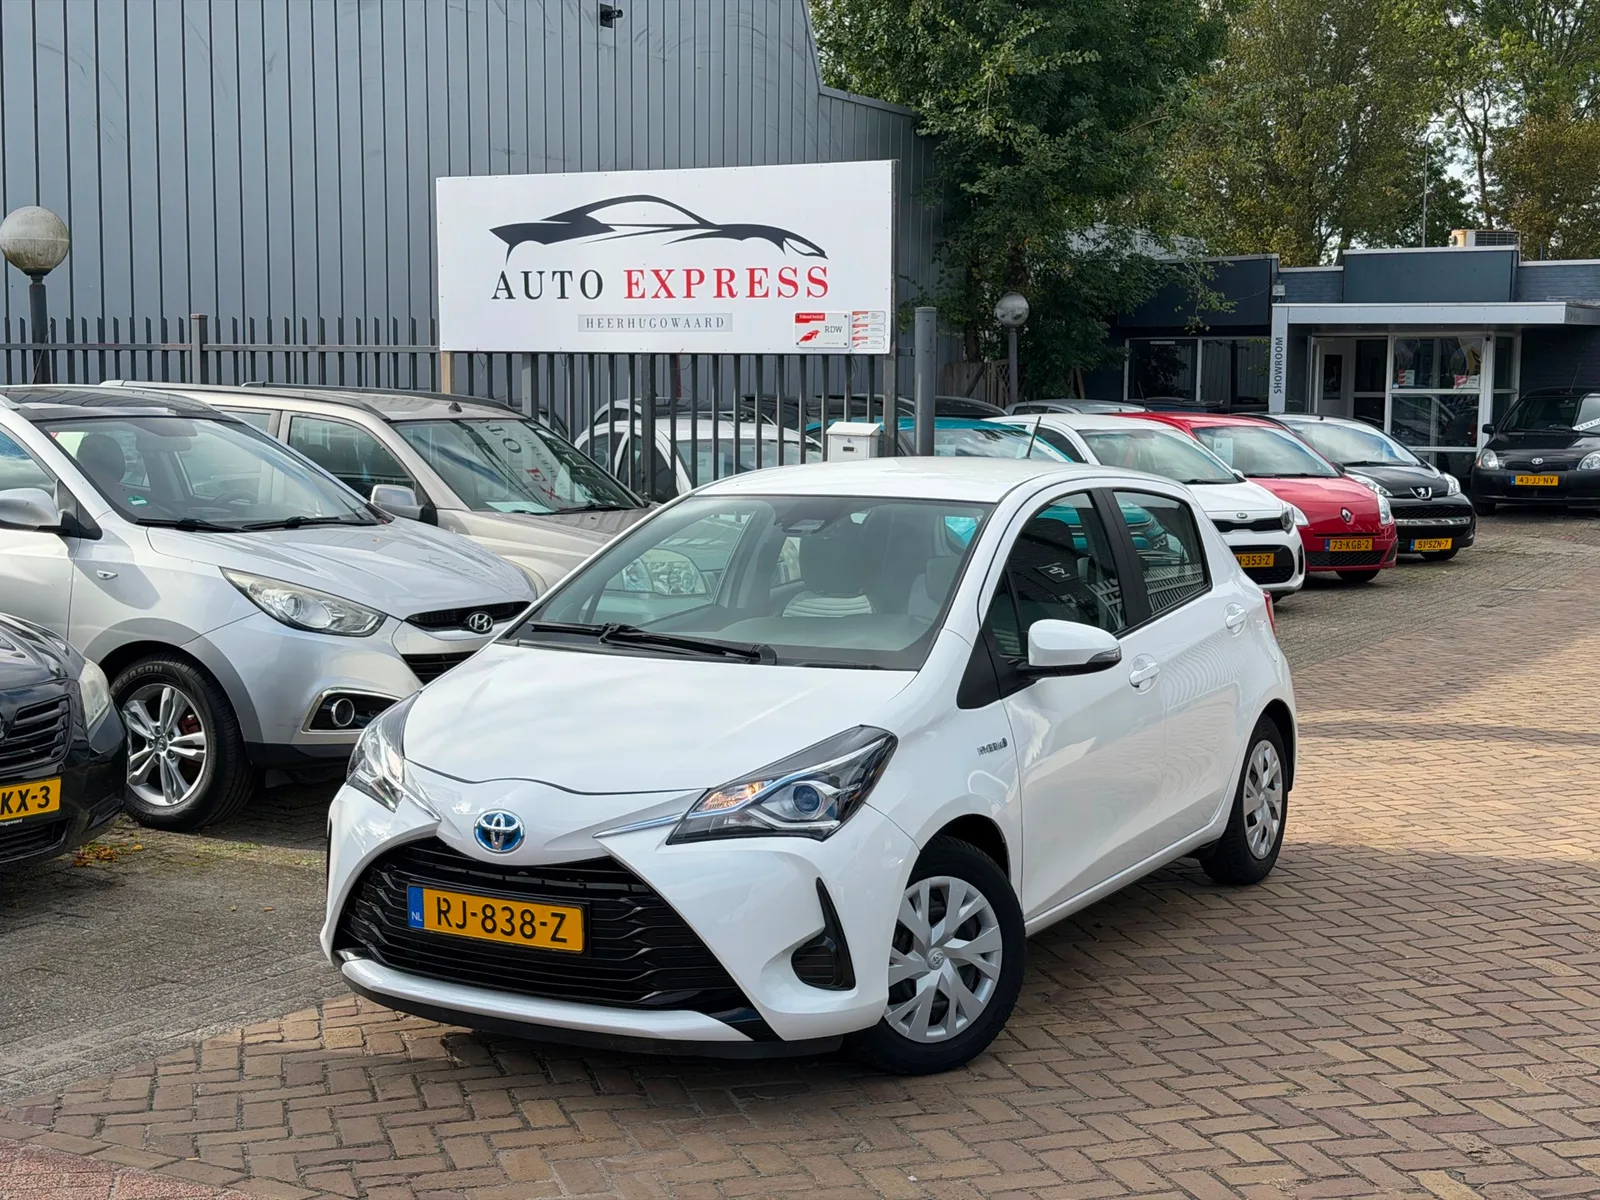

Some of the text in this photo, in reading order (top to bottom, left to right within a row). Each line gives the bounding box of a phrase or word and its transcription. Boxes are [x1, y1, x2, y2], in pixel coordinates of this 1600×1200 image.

[491, 266, 829, 300] AUTO EXPRESS
[585, 317, 725, 329] HEERHUGOWAARD
[824, 325, 842, 333] RDW
[1273, 337, 1284, 394] SHOWROOM
[1518, 476, 1555, 485] 43-JJ-NV
[1332, 540, 1370, 549] 73-KGB-2
[0, 785, 51, 815] KX-3
[411, 911, 423, 922] NL
[436, 897, 568, 943] RJ-838-Z
